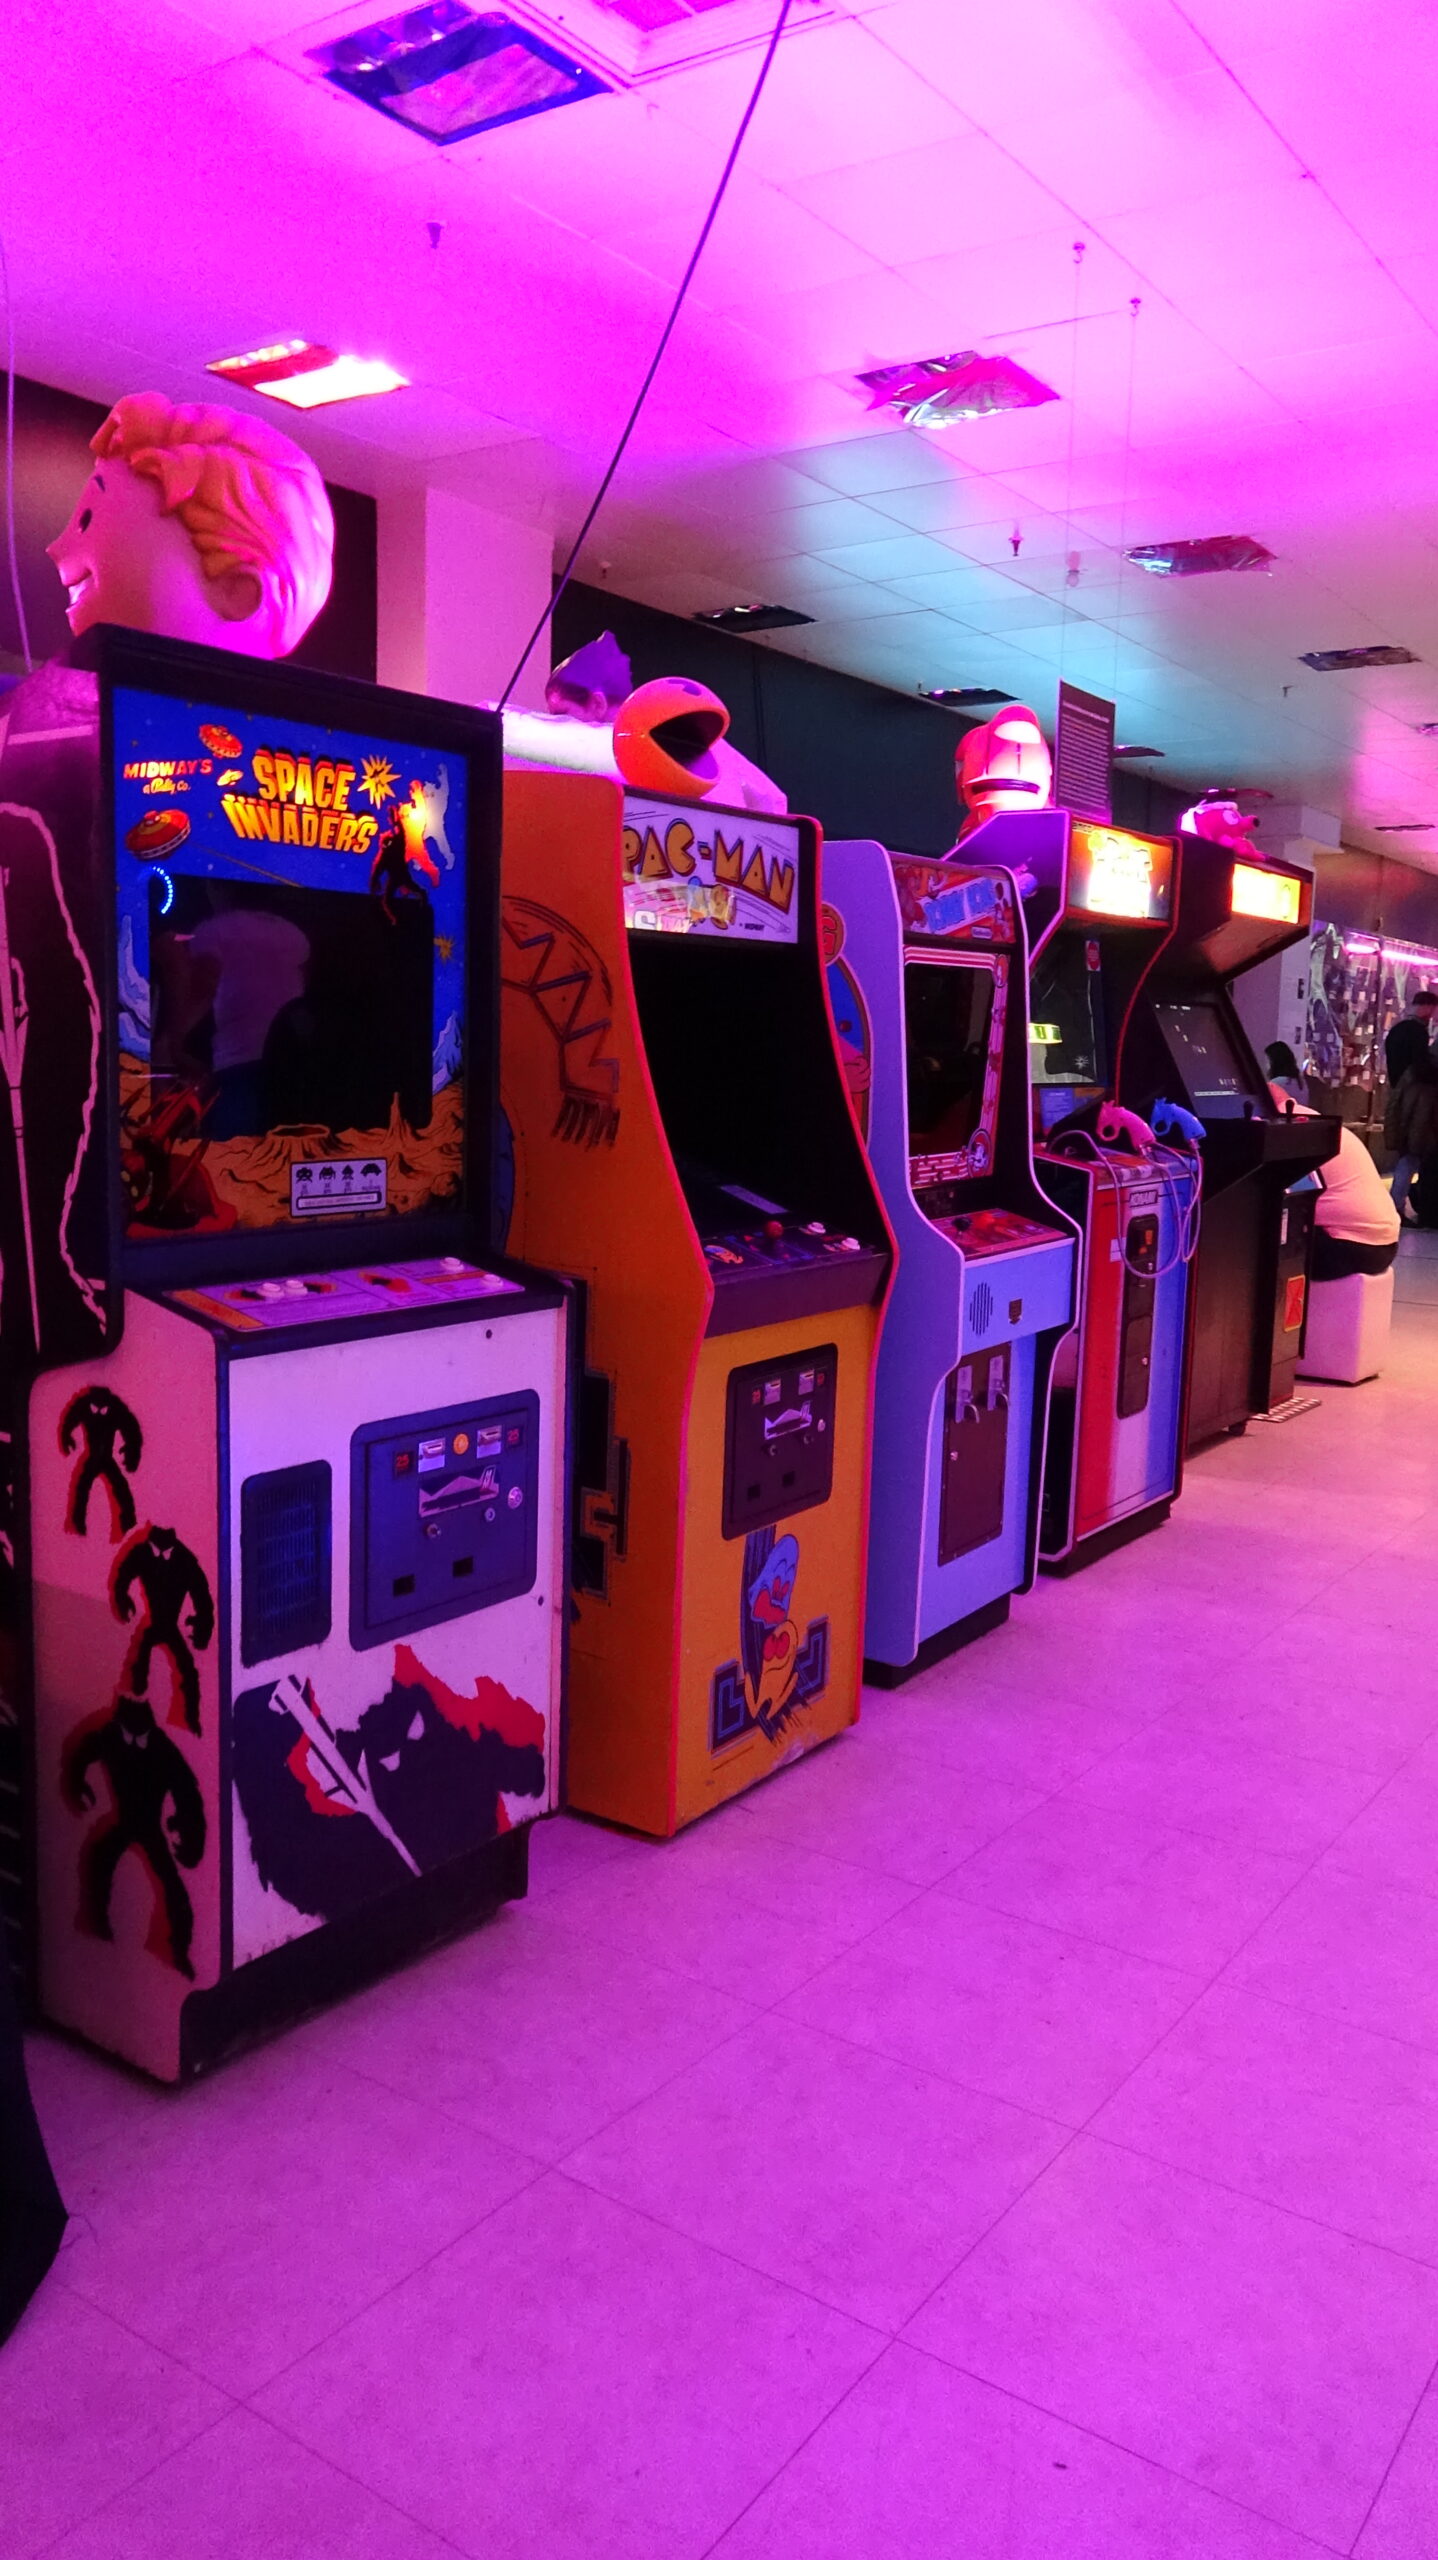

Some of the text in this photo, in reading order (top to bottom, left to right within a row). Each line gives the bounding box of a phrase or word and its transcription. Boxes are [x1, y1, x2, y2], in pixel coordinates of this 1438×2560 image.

[123, 759, 213, 779] MIDWAY'S
[252, 747, 357, 811] SPACE
[221, 794, 378, 854] INVADERS
[623, 817, 795, 915] PAC-MAN
